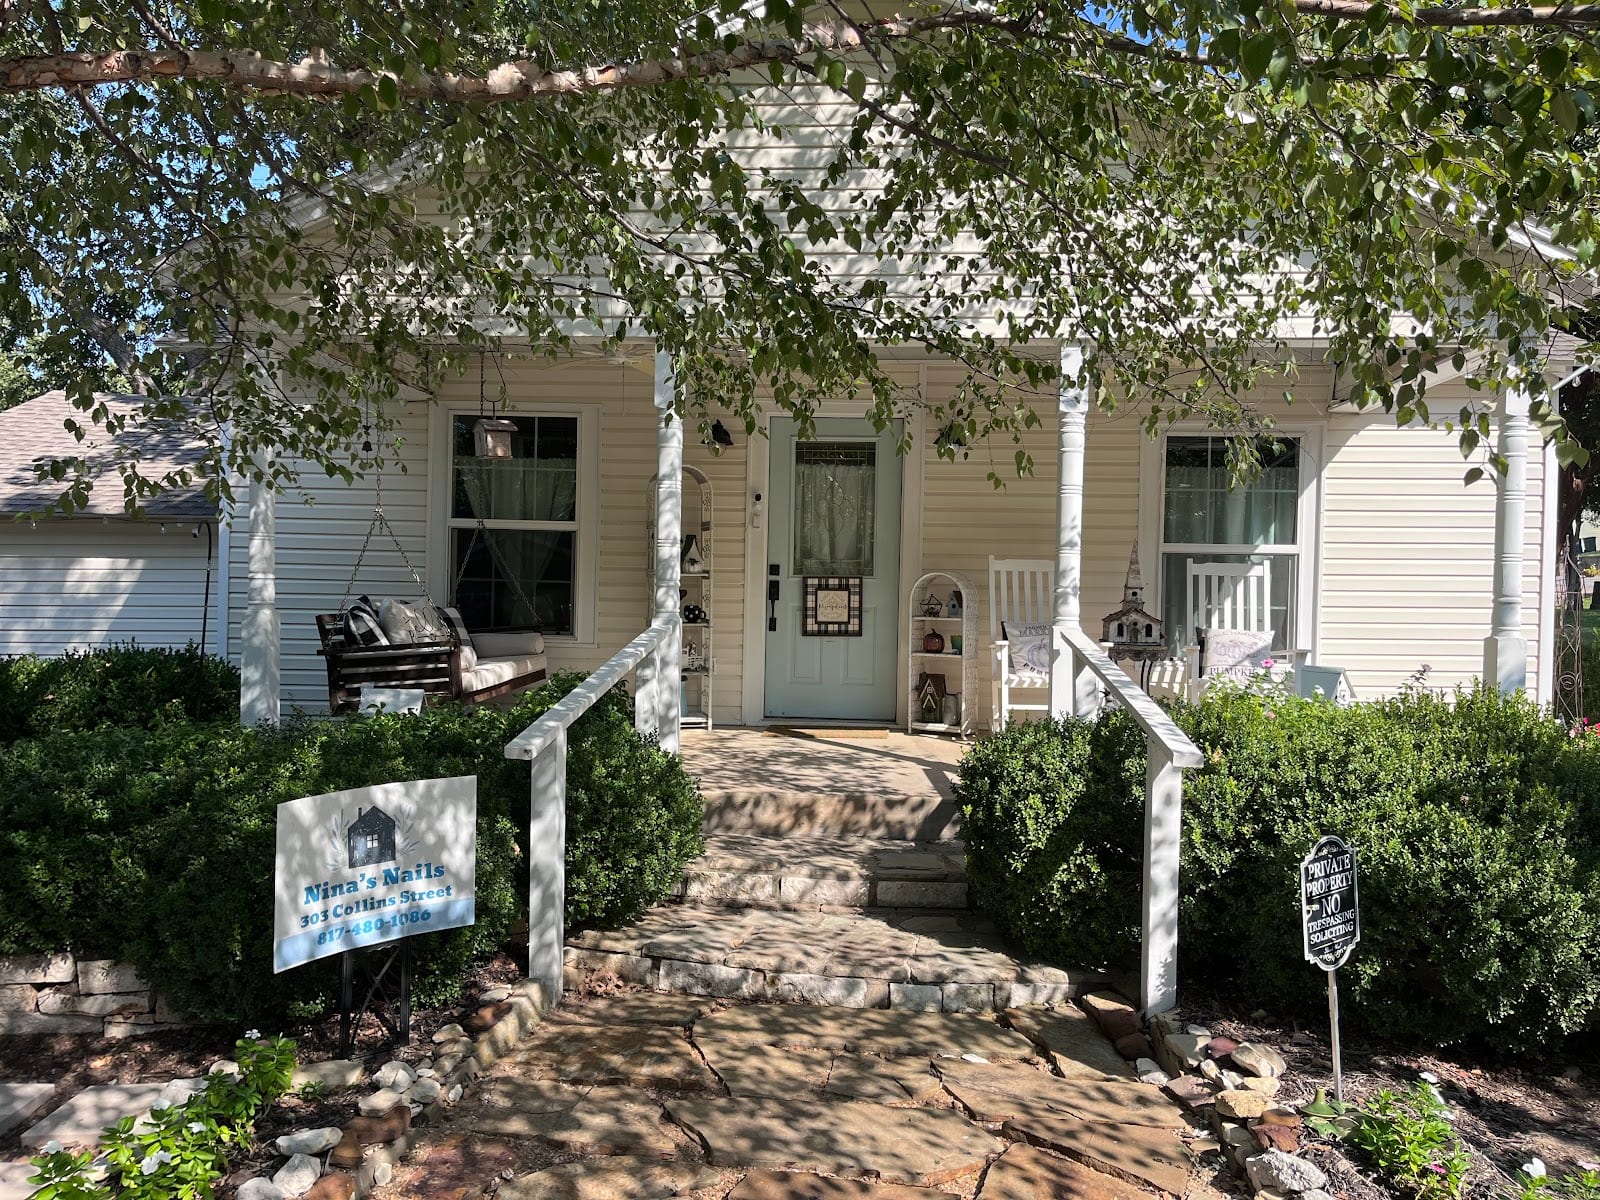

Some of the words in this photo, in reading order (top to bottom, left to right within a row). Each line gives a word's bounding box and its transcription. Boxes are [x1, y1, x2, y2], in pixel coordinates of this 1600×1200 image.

[1210, 667, 1255, 676] PUMPKI
[1308, 853, 1351, 880] PRIVATE
[304, 873, 377, 905] Nina's
[383, 862, 445, 886] Nails
[1306, 871, 1353, 897] PROPERTY
[301, 909, 329, 928] 303
[332, 896, 396, 918] Collins
[400, 885, 452, 904] Street
[1321, 893, 1341, 918] NO
[317, 909, 431, 945] 817-480-1086
[1308, 909, 1355, 933] TRESPASSING
[1310, 922, 1354, 945] SOLICITING
